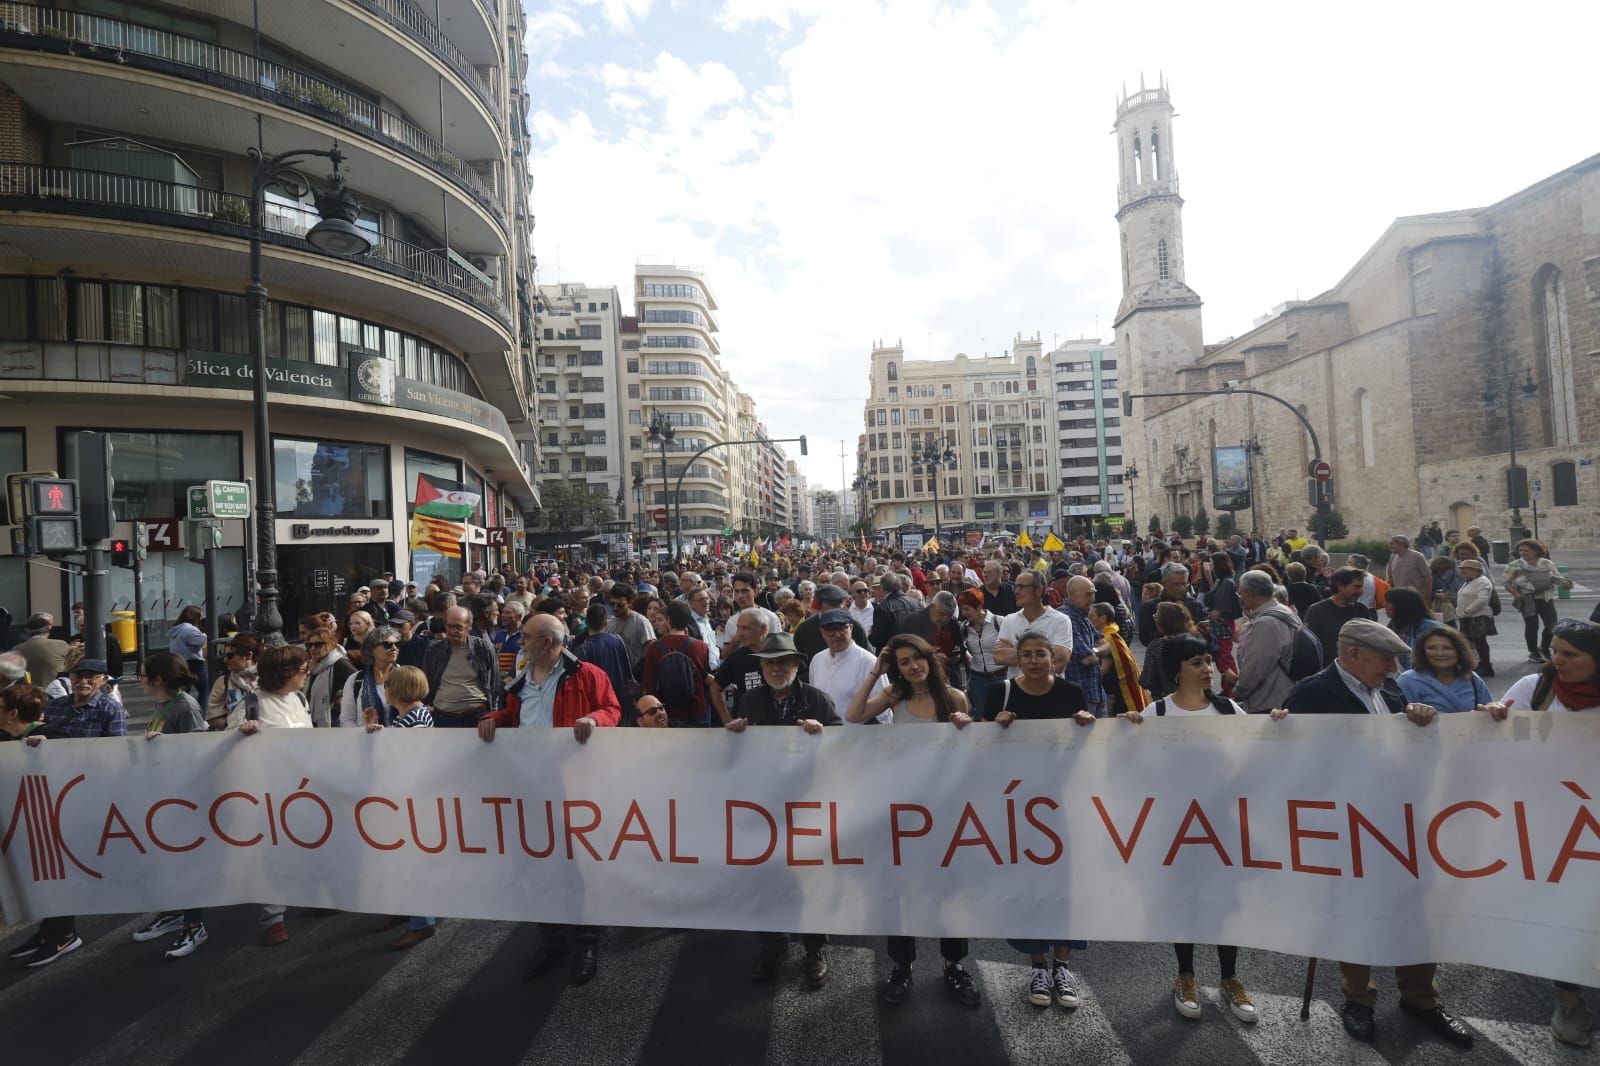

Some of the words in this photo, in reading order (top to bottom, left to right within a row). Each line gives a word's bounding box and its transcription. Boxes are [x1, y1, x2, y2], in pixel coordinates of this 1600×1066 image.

[265, 367, 333, 388] Valencia
[407, 386, 426, 402] San
[97, 777, 334, 856] ACCIÓ
[354, 795, 699, 864] CULTURAL
[725, 799, 864, 867] DEL
[890, 779, 1064, 867] PAÍS
[1090, 781, 1600, 884] VALENCIÀ
